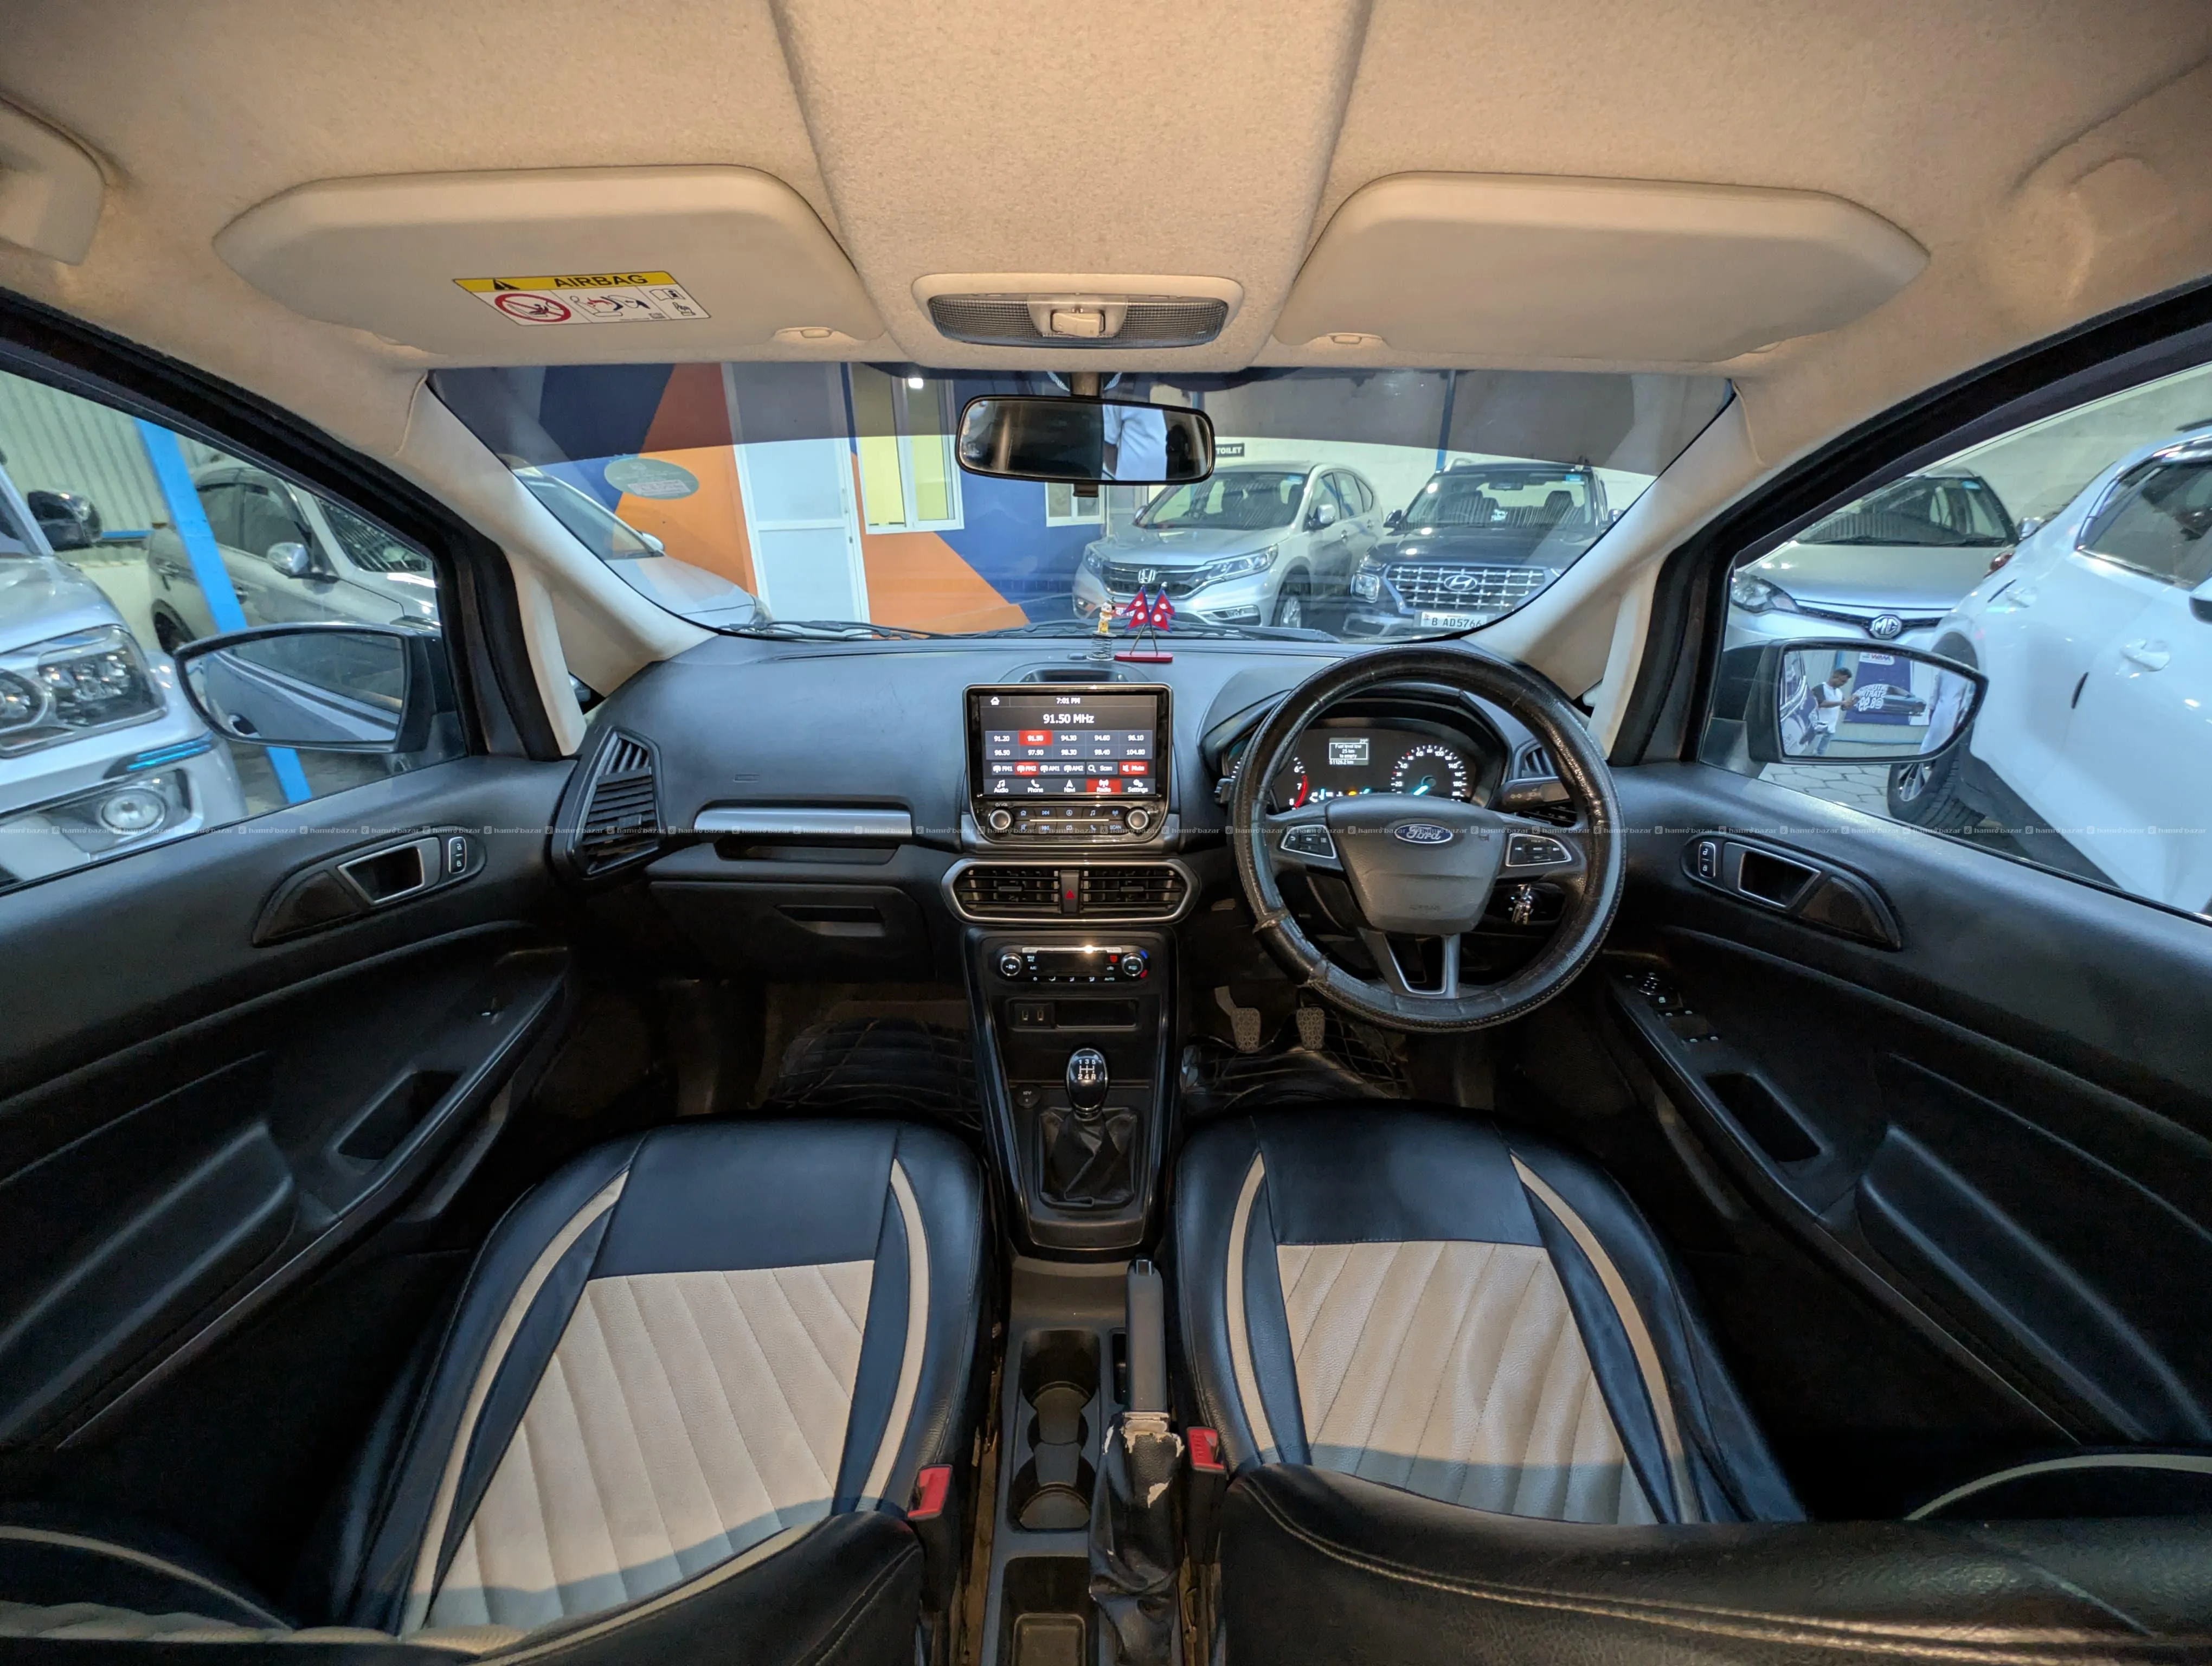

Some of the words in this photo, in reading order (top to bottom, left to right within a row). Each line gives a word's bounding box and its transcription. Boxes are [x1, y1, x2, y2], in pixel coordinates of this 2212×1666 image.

[554, 274, 648, 287] AIRBAG
[1216, 446, 1242, 455] TOILET
[1431, 617, 1438, 626] B
[1874, 618, 1898, 635] MG
[1043, 713, 1071, 724] 91.50
[1072, 713, 1095, 724] MHz
[1289, 798, 1295, 806] 8
[1406, 825, 1442, 840] Ford
